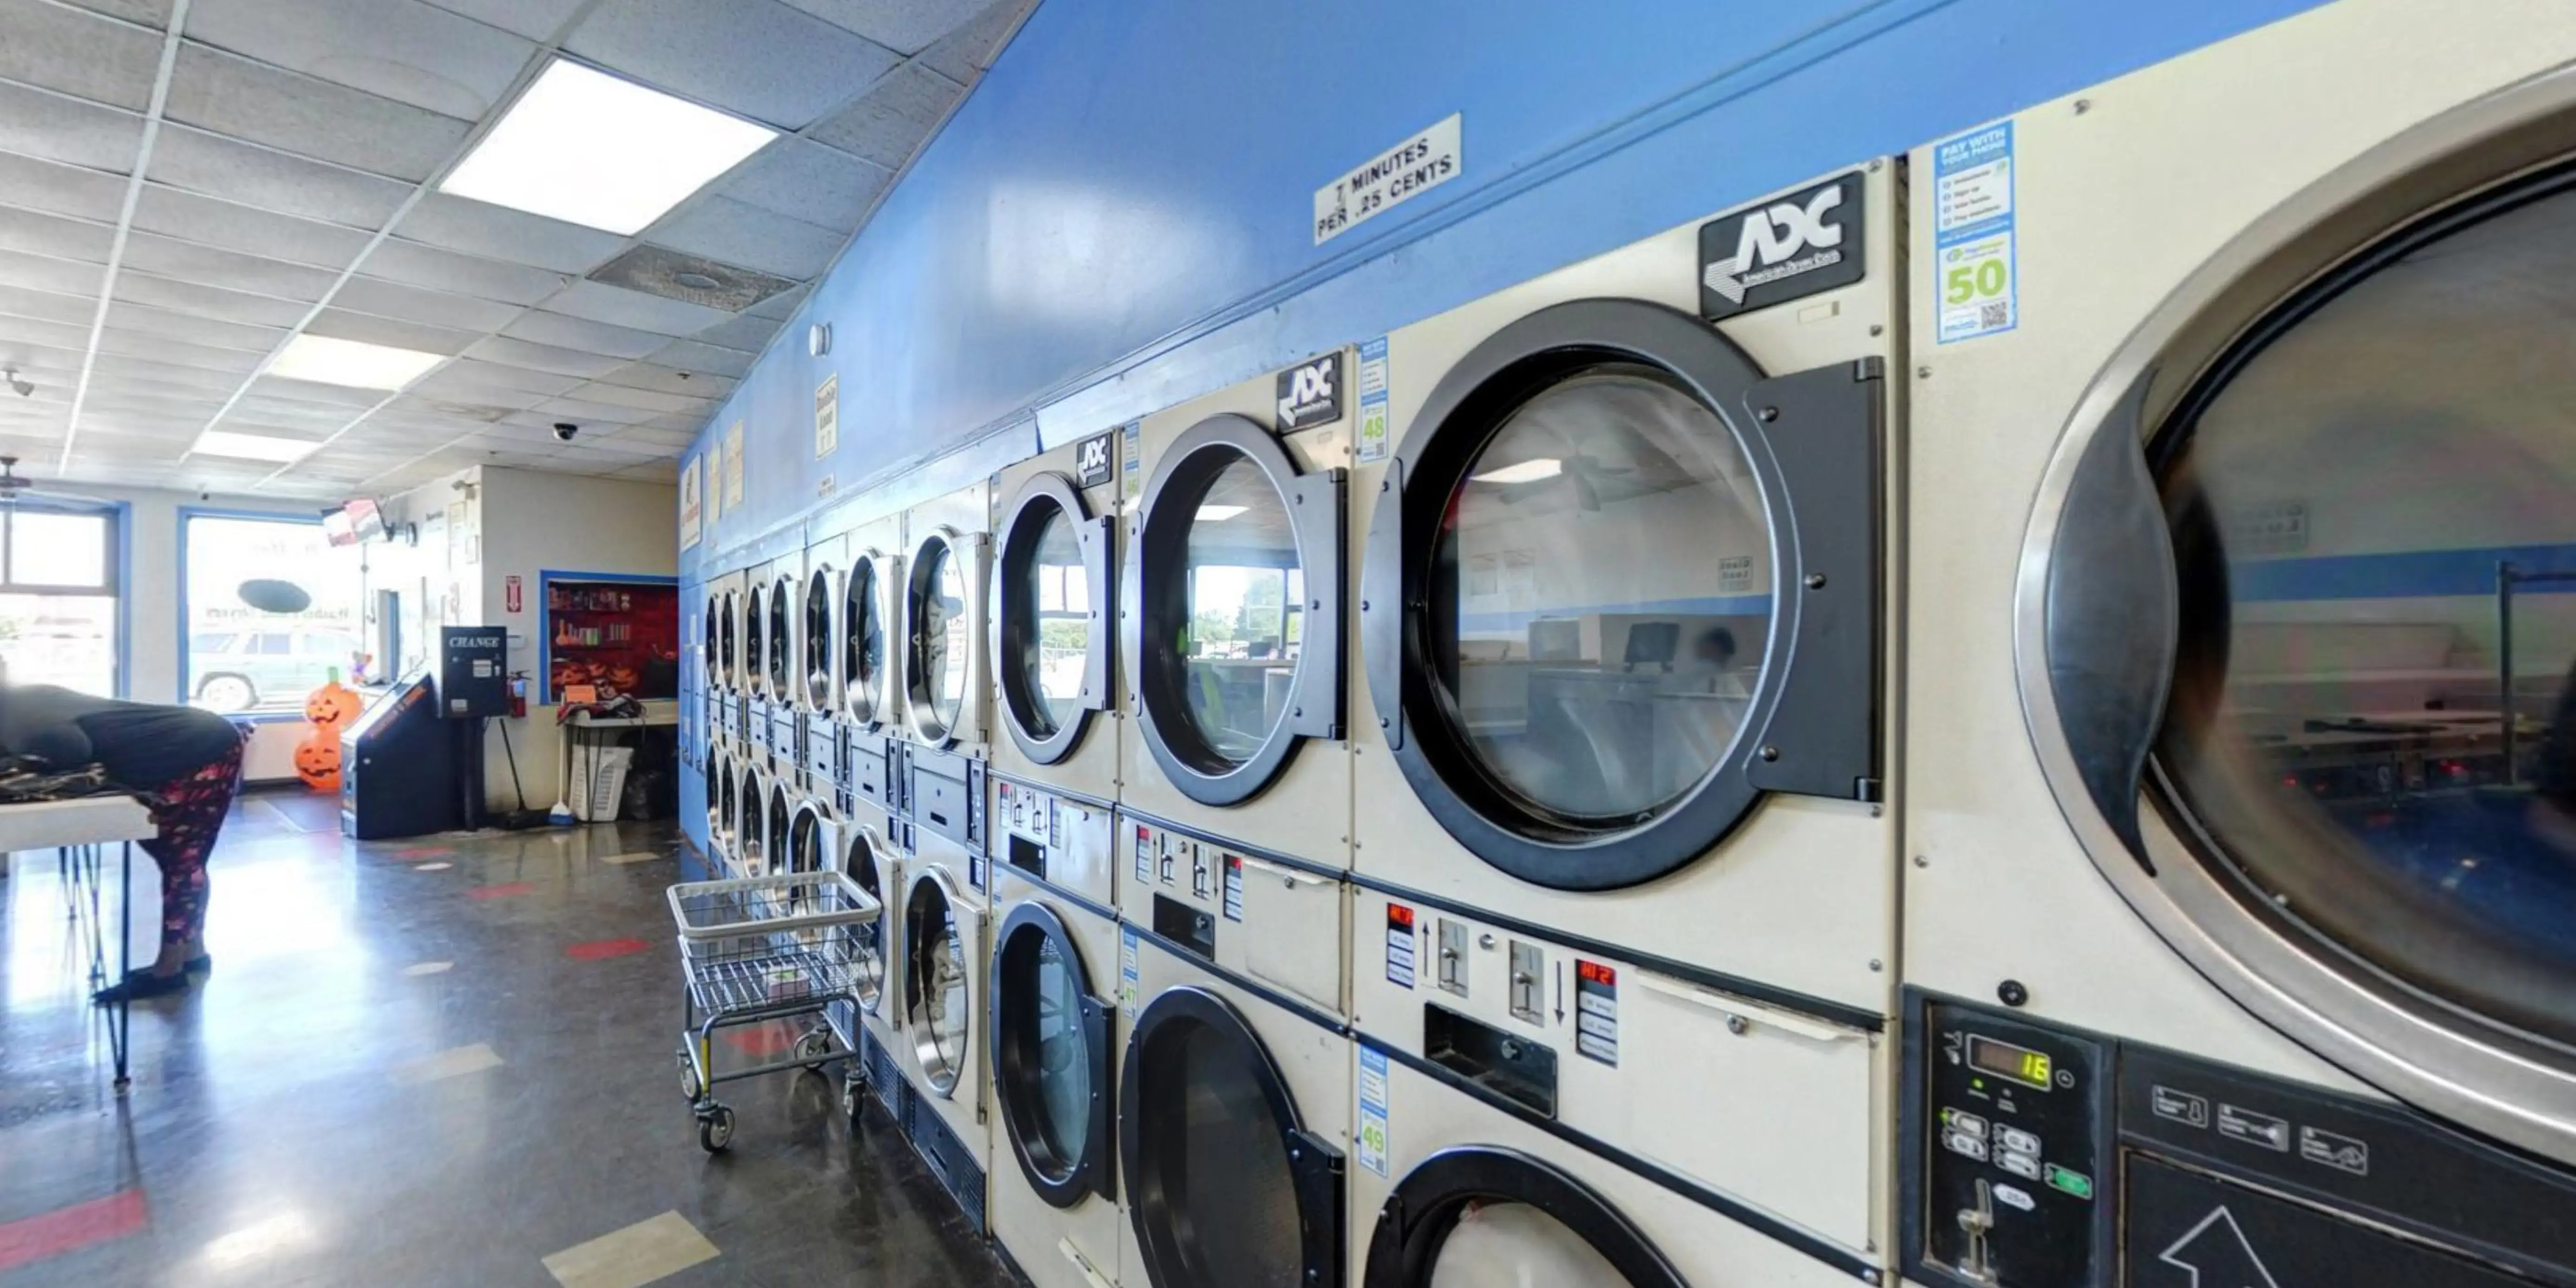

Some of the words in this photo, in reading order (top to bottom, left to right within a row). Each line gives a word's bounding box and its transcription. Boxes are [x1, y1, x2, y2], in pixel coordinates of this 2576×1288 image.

[1942, 141, 1968, 158] PAY
[1968, 126, 2006, 149] WITH
[1352, 137, 1428, 194] MINUTES
[1318, 207, 1347, 237] PER
[1390, 154, 1452, 198] CENTS
[1734, 185, 1841, 273] ADC
[1946, 258, 2007, 305] 50
[1291, 357, 1332, 407] ADC
[1363, 415, 1384, 439] 48
[1084, 437, 1106, 470] ADC
[449, 636, 500, 648] CHANGE
[1126, 987, 1136, 1005] 47
[2023, 1053, 2048, 1081] 16
[1363, 1125, 1384, 1152] 49
